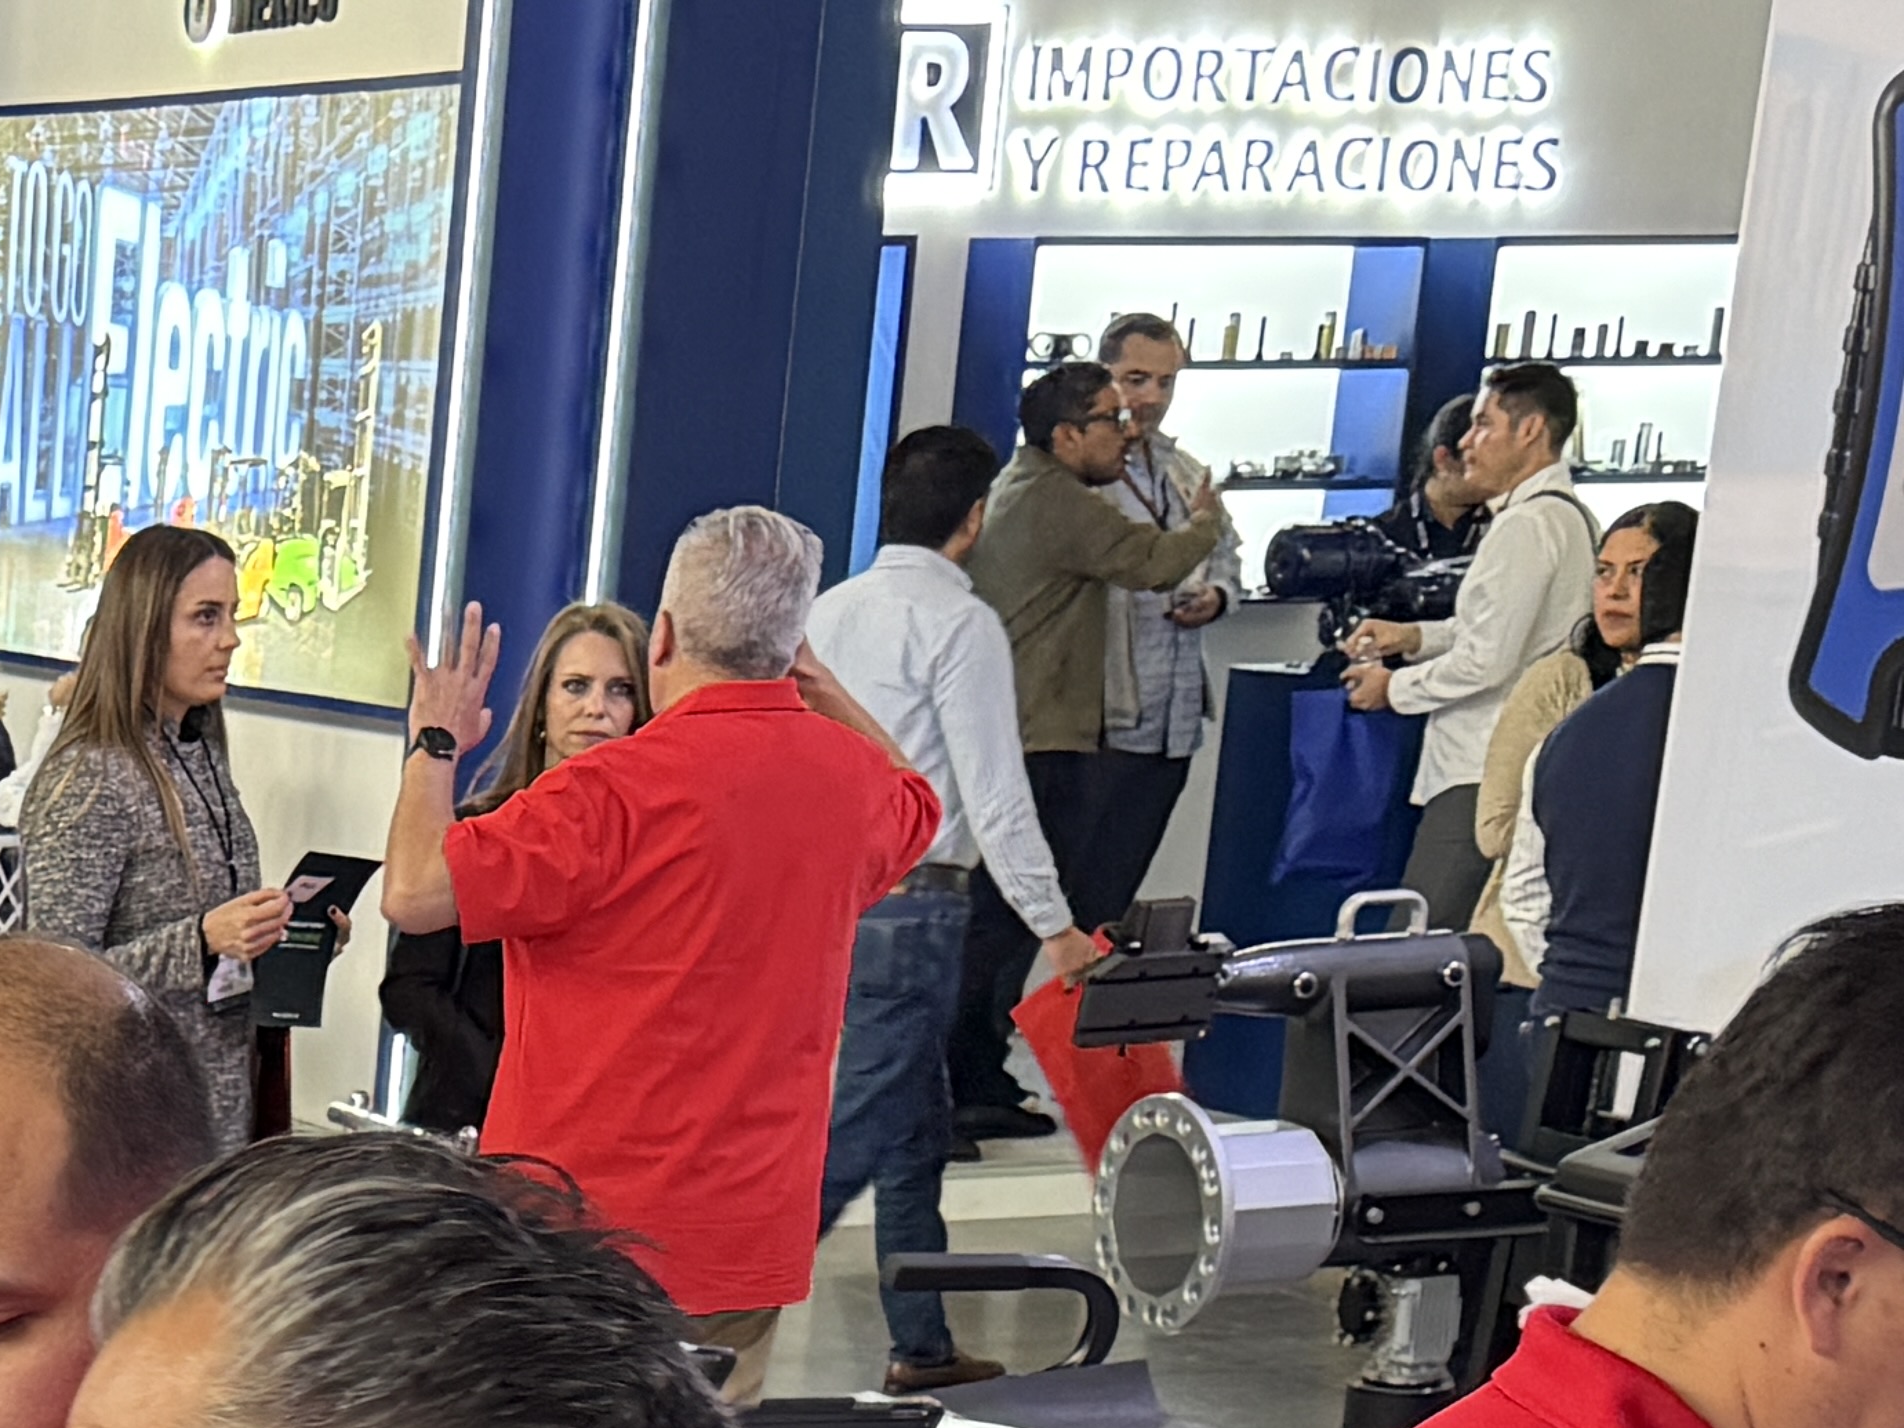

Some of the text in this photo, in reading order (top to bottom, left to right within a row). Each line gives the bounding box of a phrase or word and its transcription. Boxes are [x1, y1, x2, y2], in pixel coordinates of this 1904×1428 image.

[1026, 45, 1552, 104] IMPORTACIONES
[1023, 136, 1560, 193] Y REPARACIONES
[6, 157, 92, 326] TO GO
[94, 186, 307, 510] Electric
